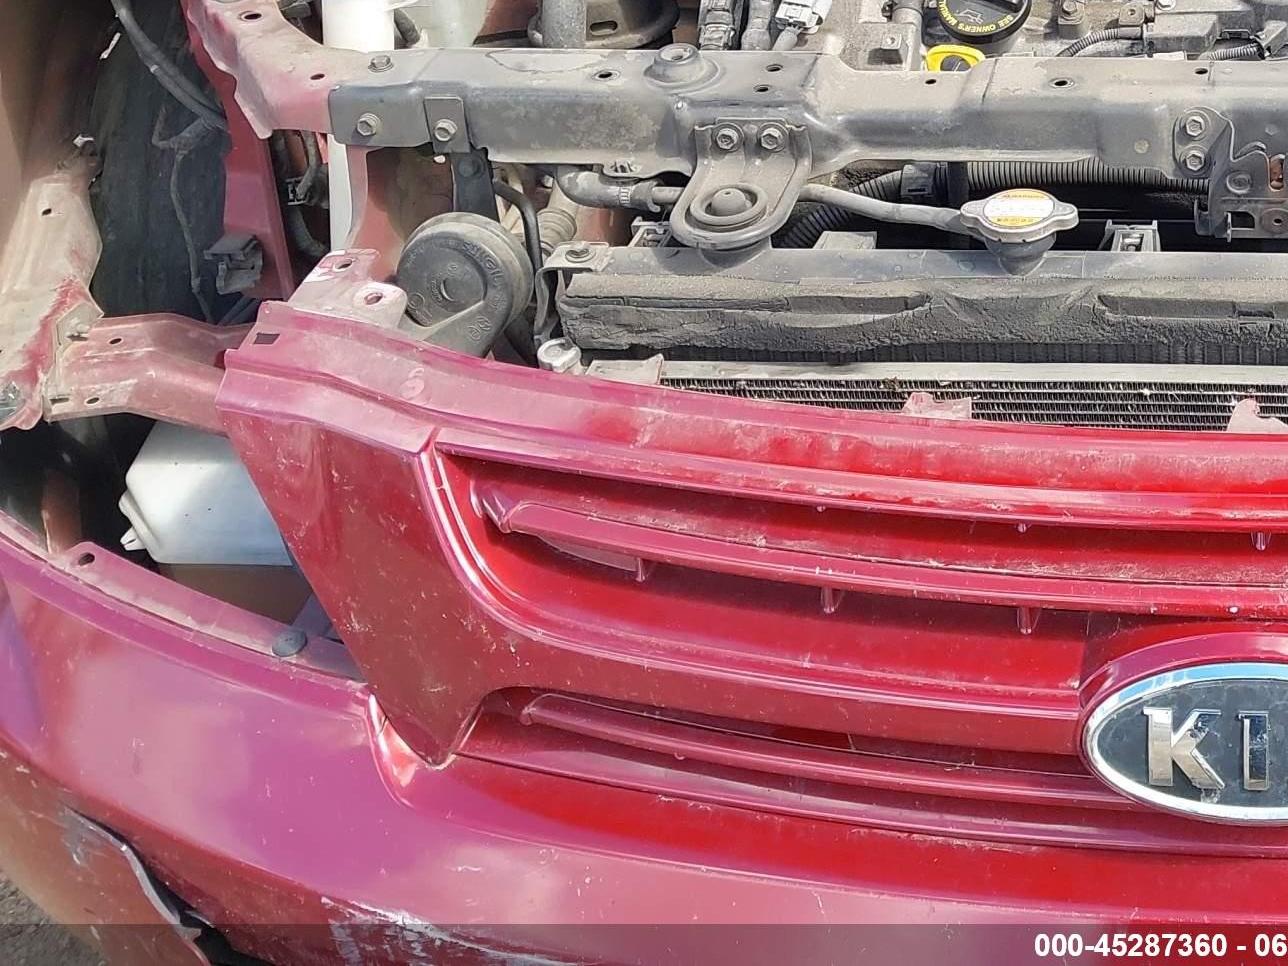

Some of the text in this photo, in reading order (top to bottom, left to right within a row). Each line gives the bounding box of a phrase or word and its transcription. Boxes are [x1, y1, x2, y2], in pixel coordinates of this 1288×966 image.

[938, 0, 1014, 33] SEE OWNER'S MANUAL
